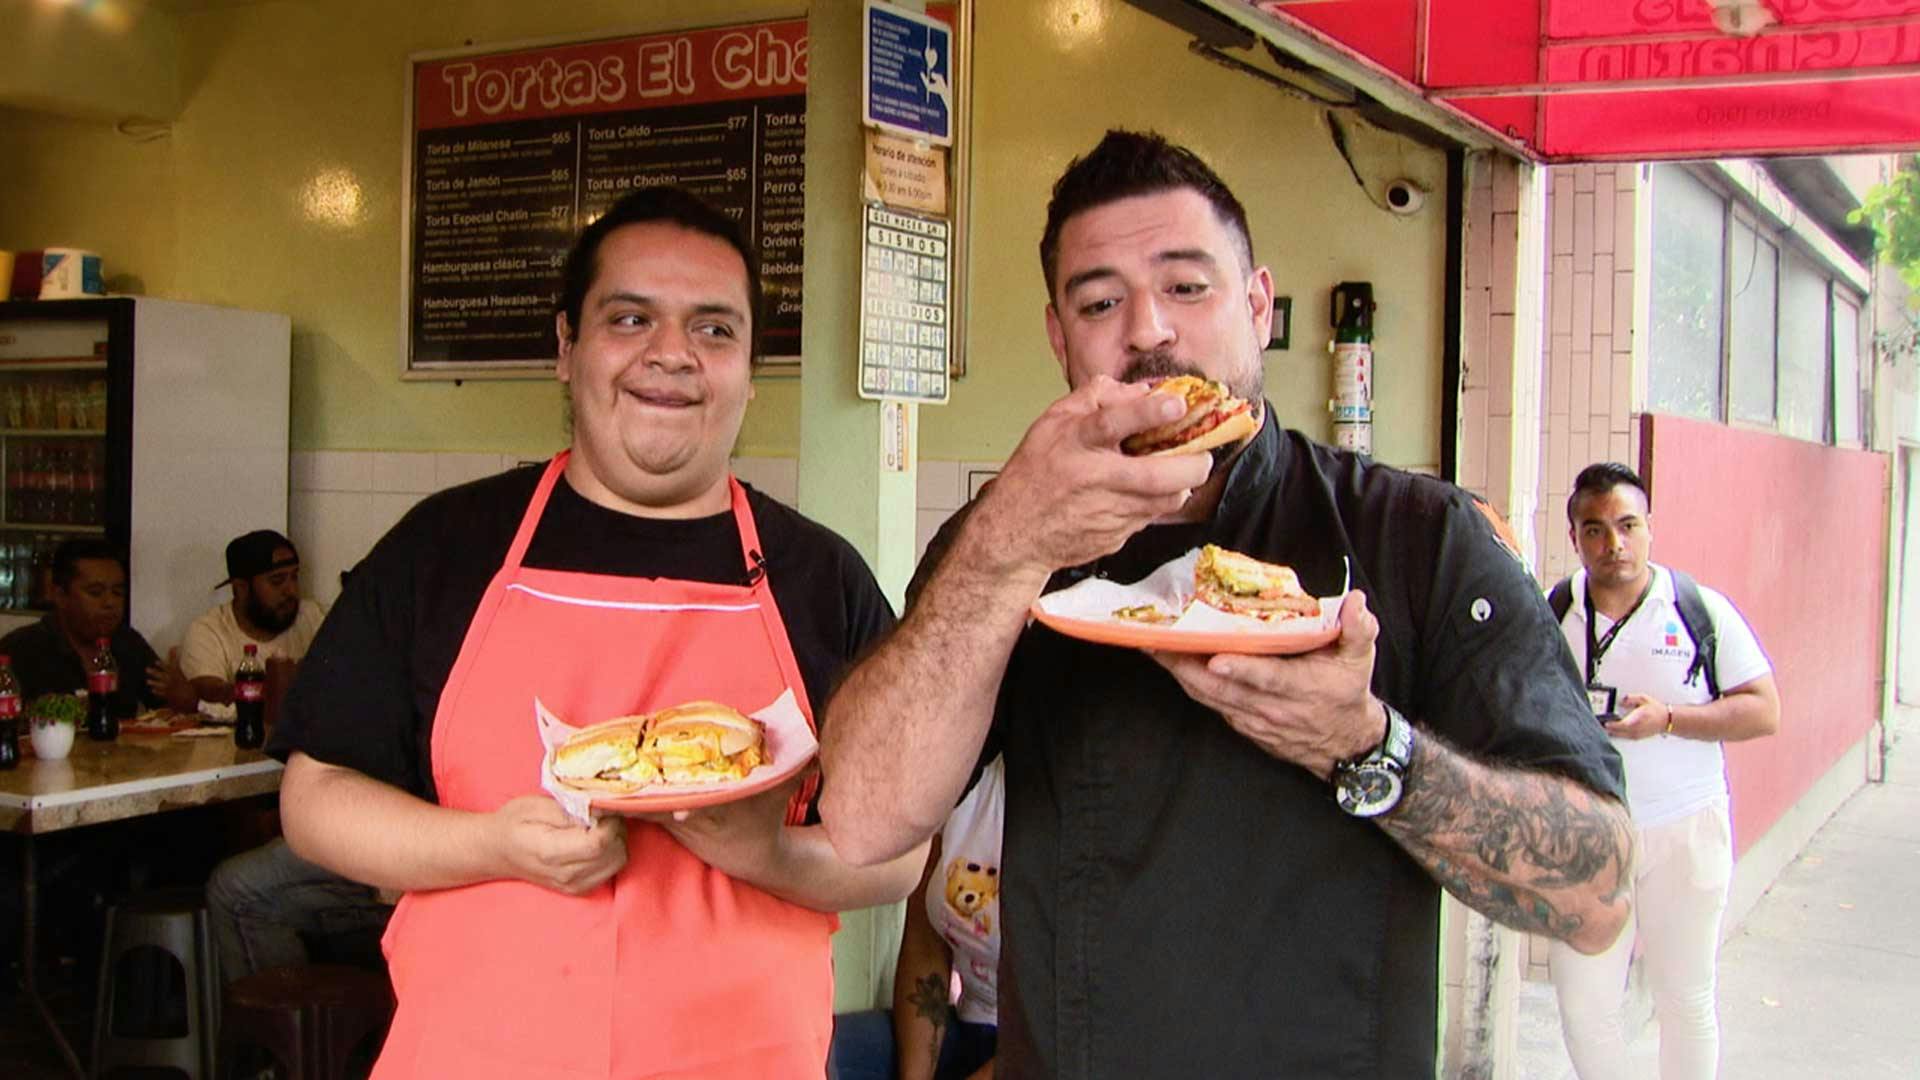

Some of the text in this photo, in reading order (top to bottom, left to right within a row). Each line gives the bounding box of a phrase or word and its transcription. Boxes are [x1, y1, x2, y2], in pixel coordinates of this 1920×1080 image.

[442, 56, 626, 117] Tortas
[639, 38, 695, 97] El
[765, 113, 797, 126] Torta
[588, 115, 748, 141] Torta Caldo $77
[427, 131, 571, 155] Torta de Milanesa $65
[764, 153, 797, 166] Perro
[896, 149, 906, 160] de
[426, 168, 569, 191] Torta de Jamón $65
[587, 168, 747, 191] Torta de Chorizo $65
[763, 181, 797, 194] Perro
[426, 216, 450, 227] Torta
[452, 212, 494, 227] Especial
[551, 206, 569, 218] $77
[724, 207, 744, 219] 77
[762, 235, 797, 248] Orden
[878, 230, 936, 254] SISMOS
[423, 260, 490, 275] Hamburguesa
[423, 296, 488, 310] Hamburguesa
[490, 294, 537, 307] Hawaiana
[871, 299, 940, 322] INCENDIOS
[1651, 648, 1690, 658] IMAGEN
